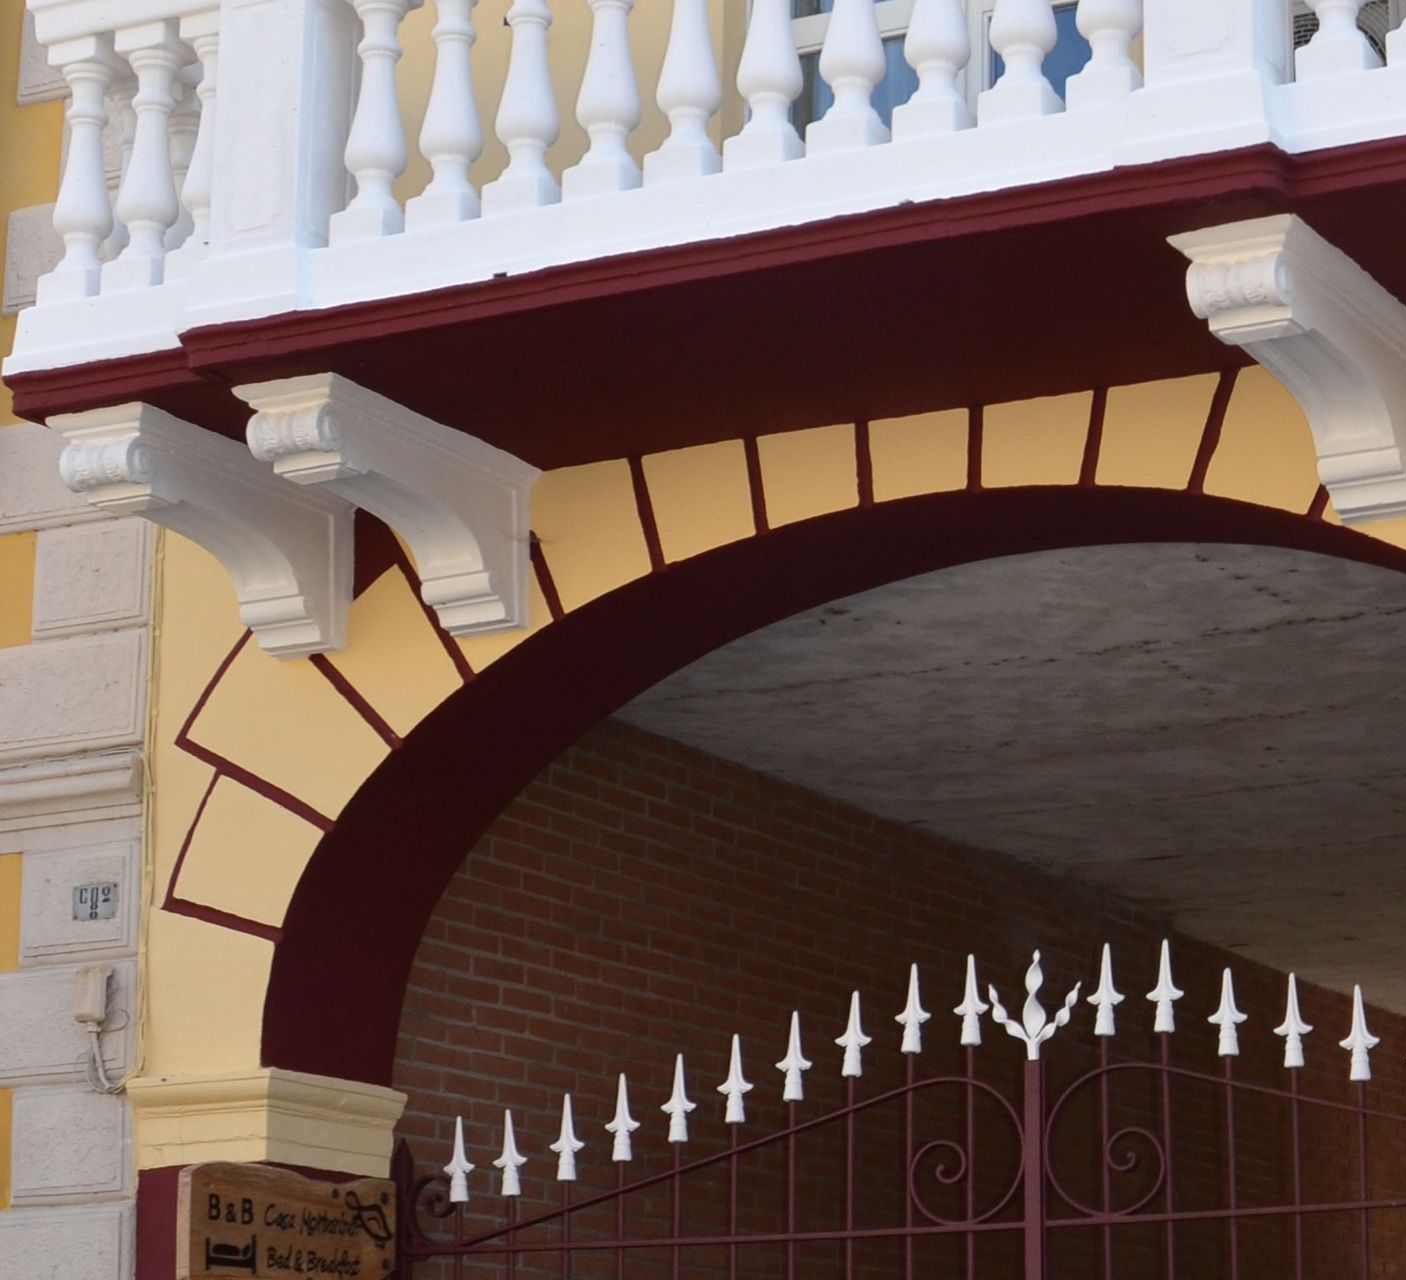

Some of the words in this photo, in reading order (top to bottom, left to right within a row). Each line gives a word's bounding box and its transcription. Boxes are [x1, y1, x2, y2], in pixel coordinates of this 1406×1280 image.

[264, 1203, 296, 1230] Casa
[266, 1246, 291, 1270] Bed
[294, 1248, 303, 1272] &
[306, 1248, 362, 1279] Breakfast
